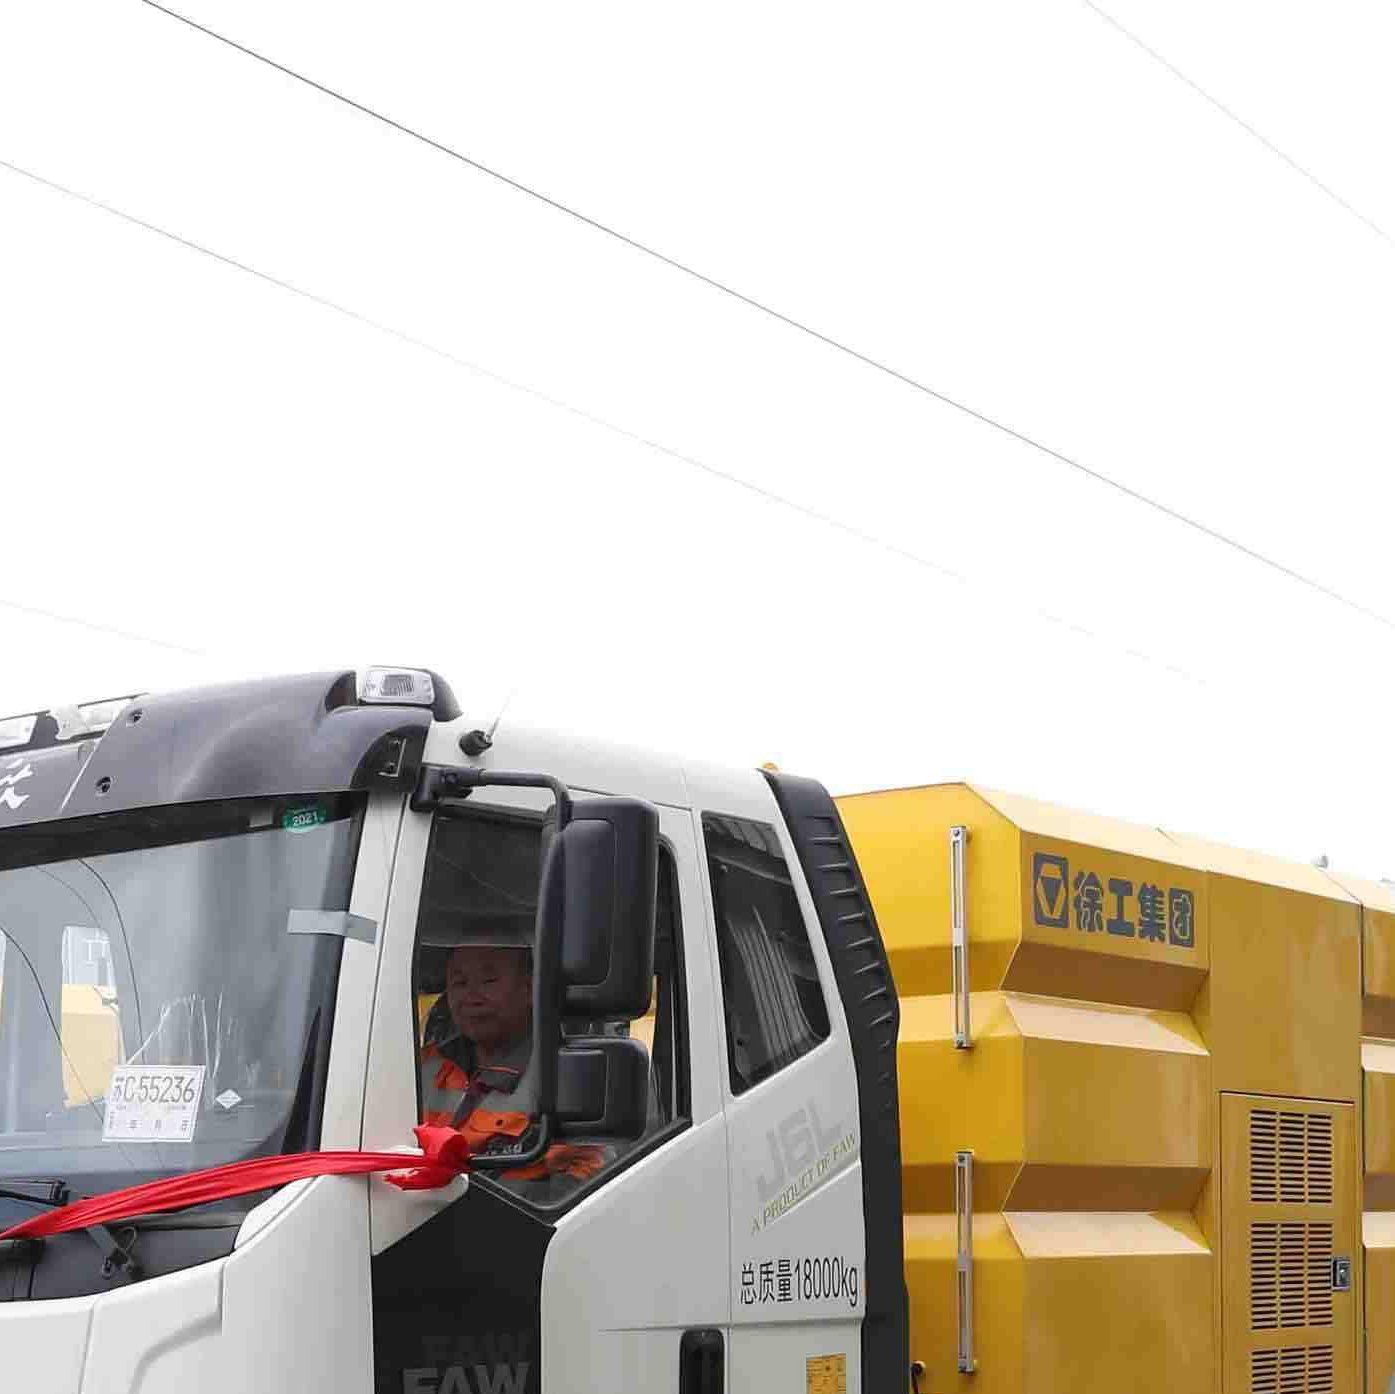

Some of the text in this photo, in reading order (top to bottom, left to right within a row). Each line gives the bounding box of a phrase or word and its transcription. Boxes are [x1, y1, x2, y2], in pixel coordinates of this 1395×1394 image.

[1073, 871, 1195, 947] 徐工集团
[740, 1255, 857, 1307] 总质量18000kg
